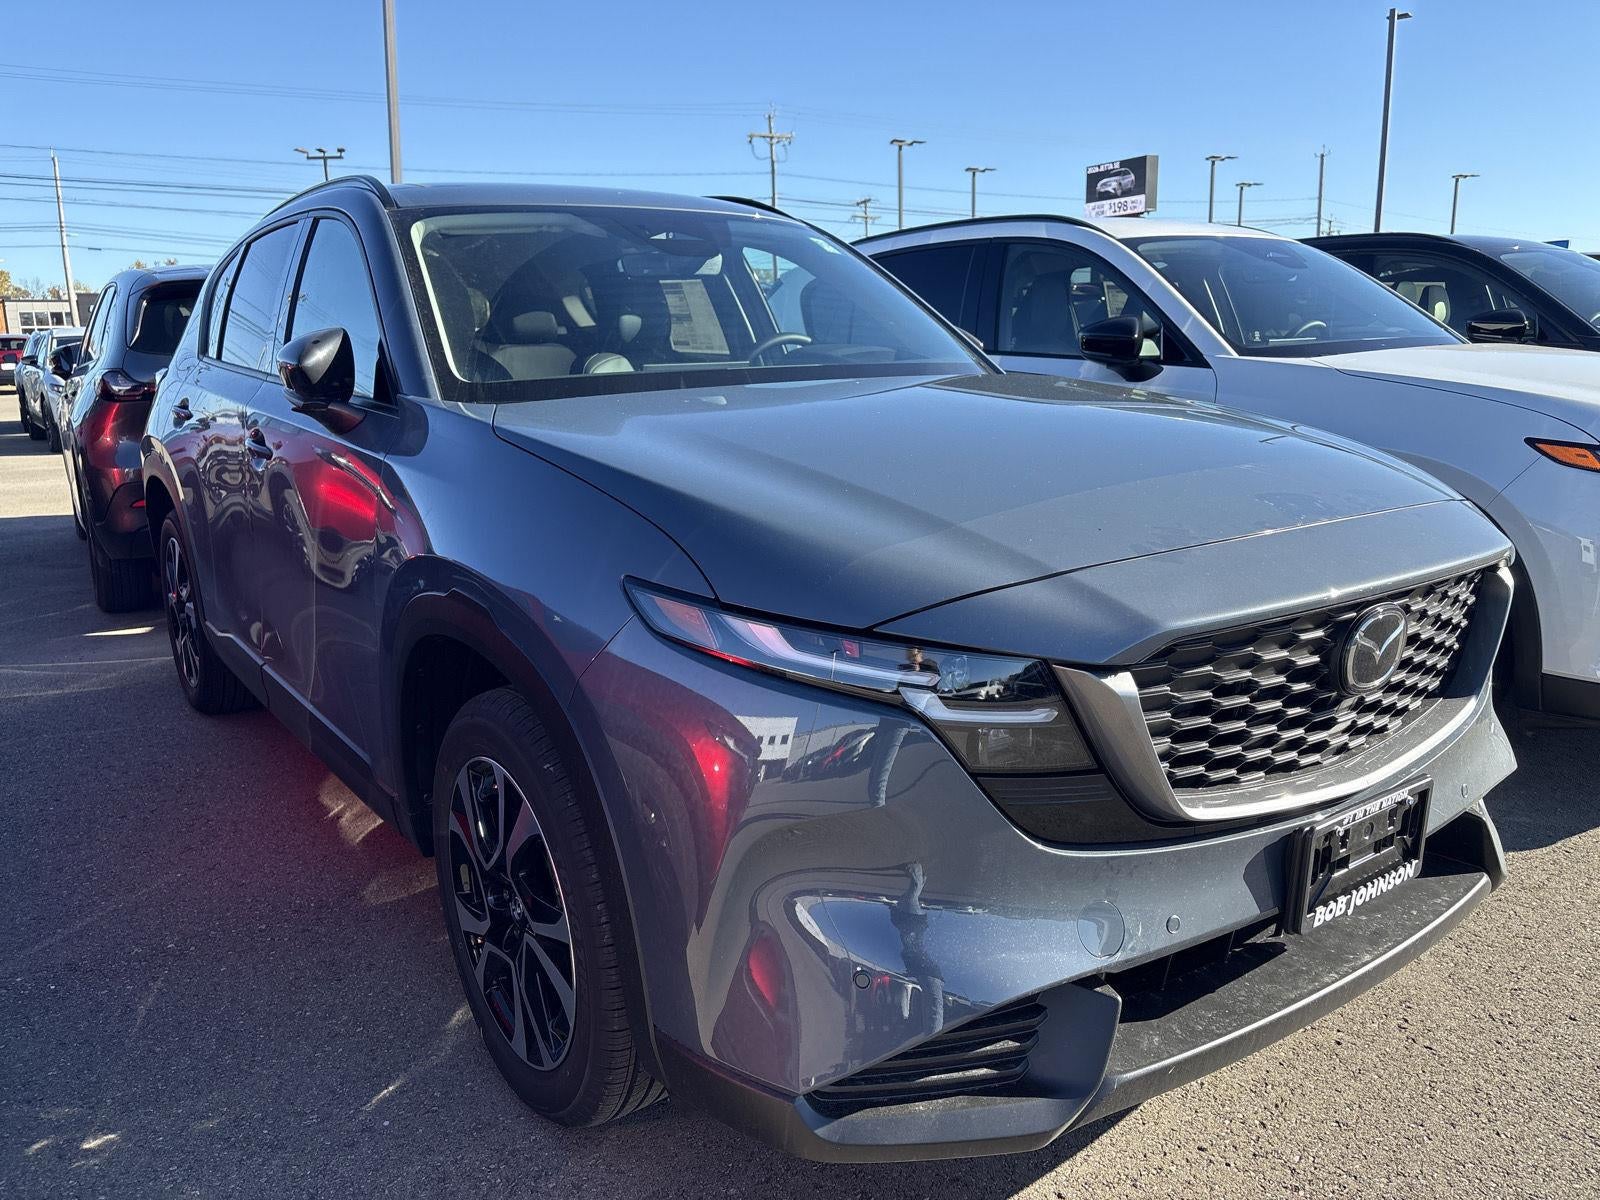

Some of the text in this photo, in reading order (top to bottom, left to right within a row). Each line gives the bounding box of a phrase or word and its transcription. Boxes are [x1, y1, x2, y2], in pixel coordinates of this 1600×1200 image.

[1109, 200, 1128, 213] $198
[1355, 810, 1365, 821] IN
[1366, 801, 1380, 816] THE
[1381, 789, 1408, 808] NATION
[1313, 859, 1419, 928] BOB JOHNSON
